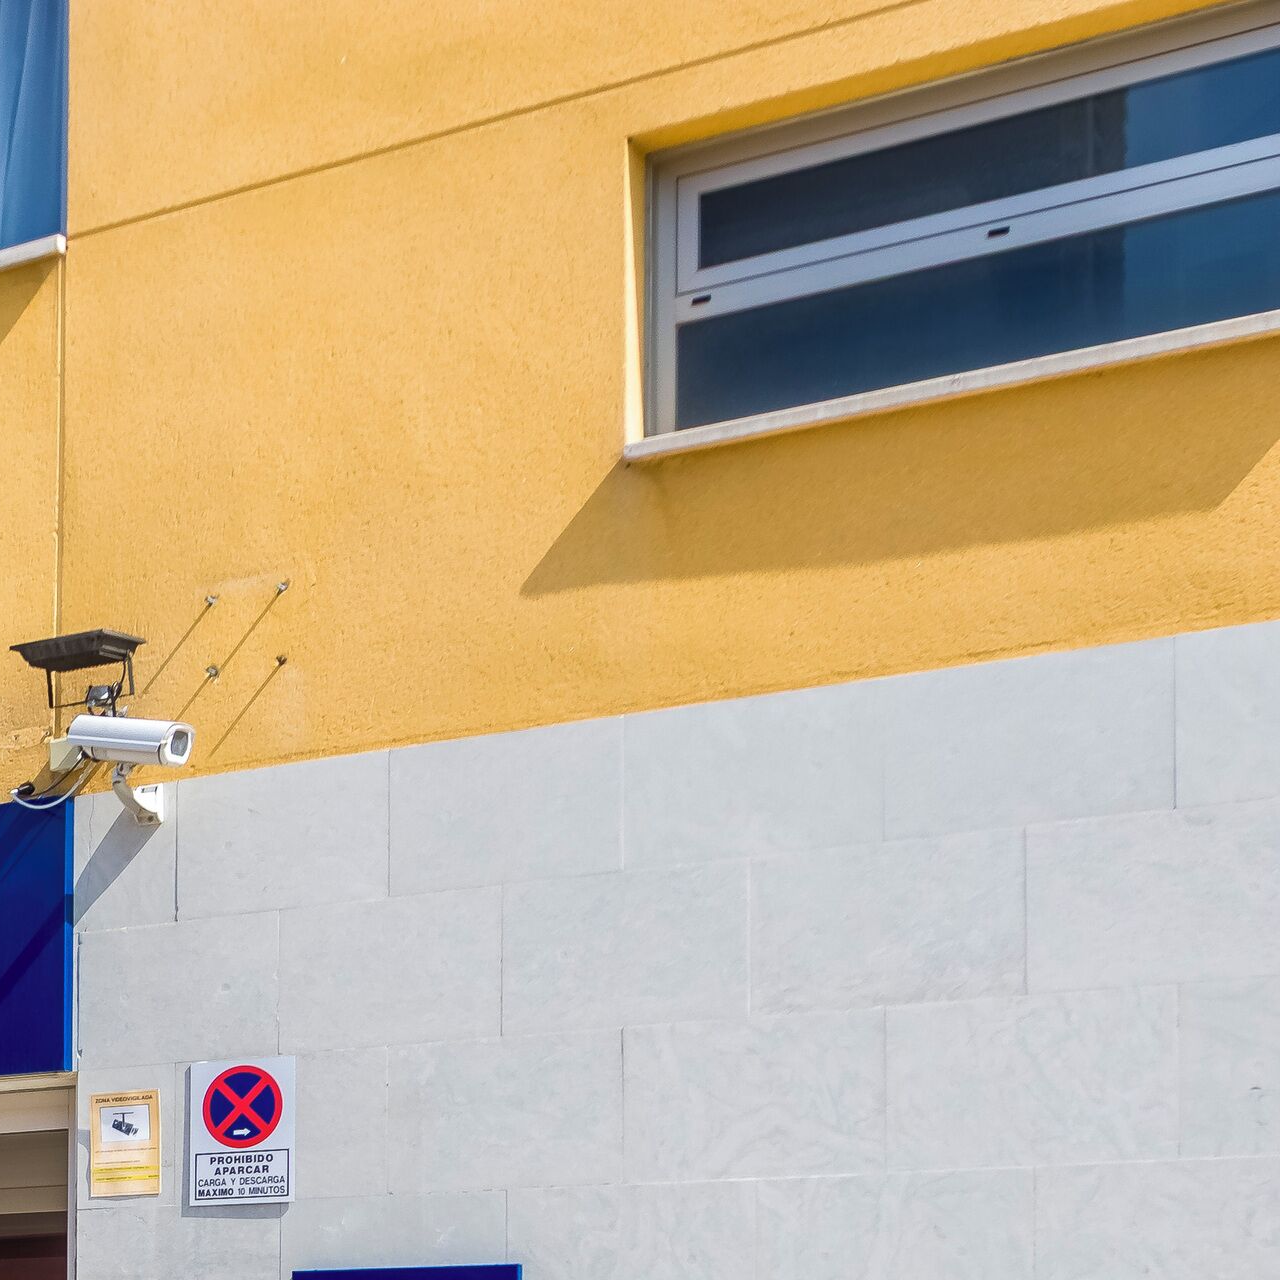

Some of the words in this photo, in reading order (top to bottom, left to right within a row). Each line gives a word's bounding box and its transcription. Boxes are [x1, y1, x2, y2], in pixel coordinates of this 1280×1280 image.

[110, 1094, 153, 1103] VIDEOVIGILADA
[209, 1153, 274, 1166] PROHIBIDO
[214, 1164, 270, 1176] APARCAR
[198, 1176, 227, 1188] CARGA
[230, 1176, 236, 1186] Y
[239, 1175, 286, 1186] DESCARGA
[197, 1187, 234, 1197] MAXIMO
[237, 1187, 244, 1196] 10
[248, 1185, 286, 1195] MINUTOS
